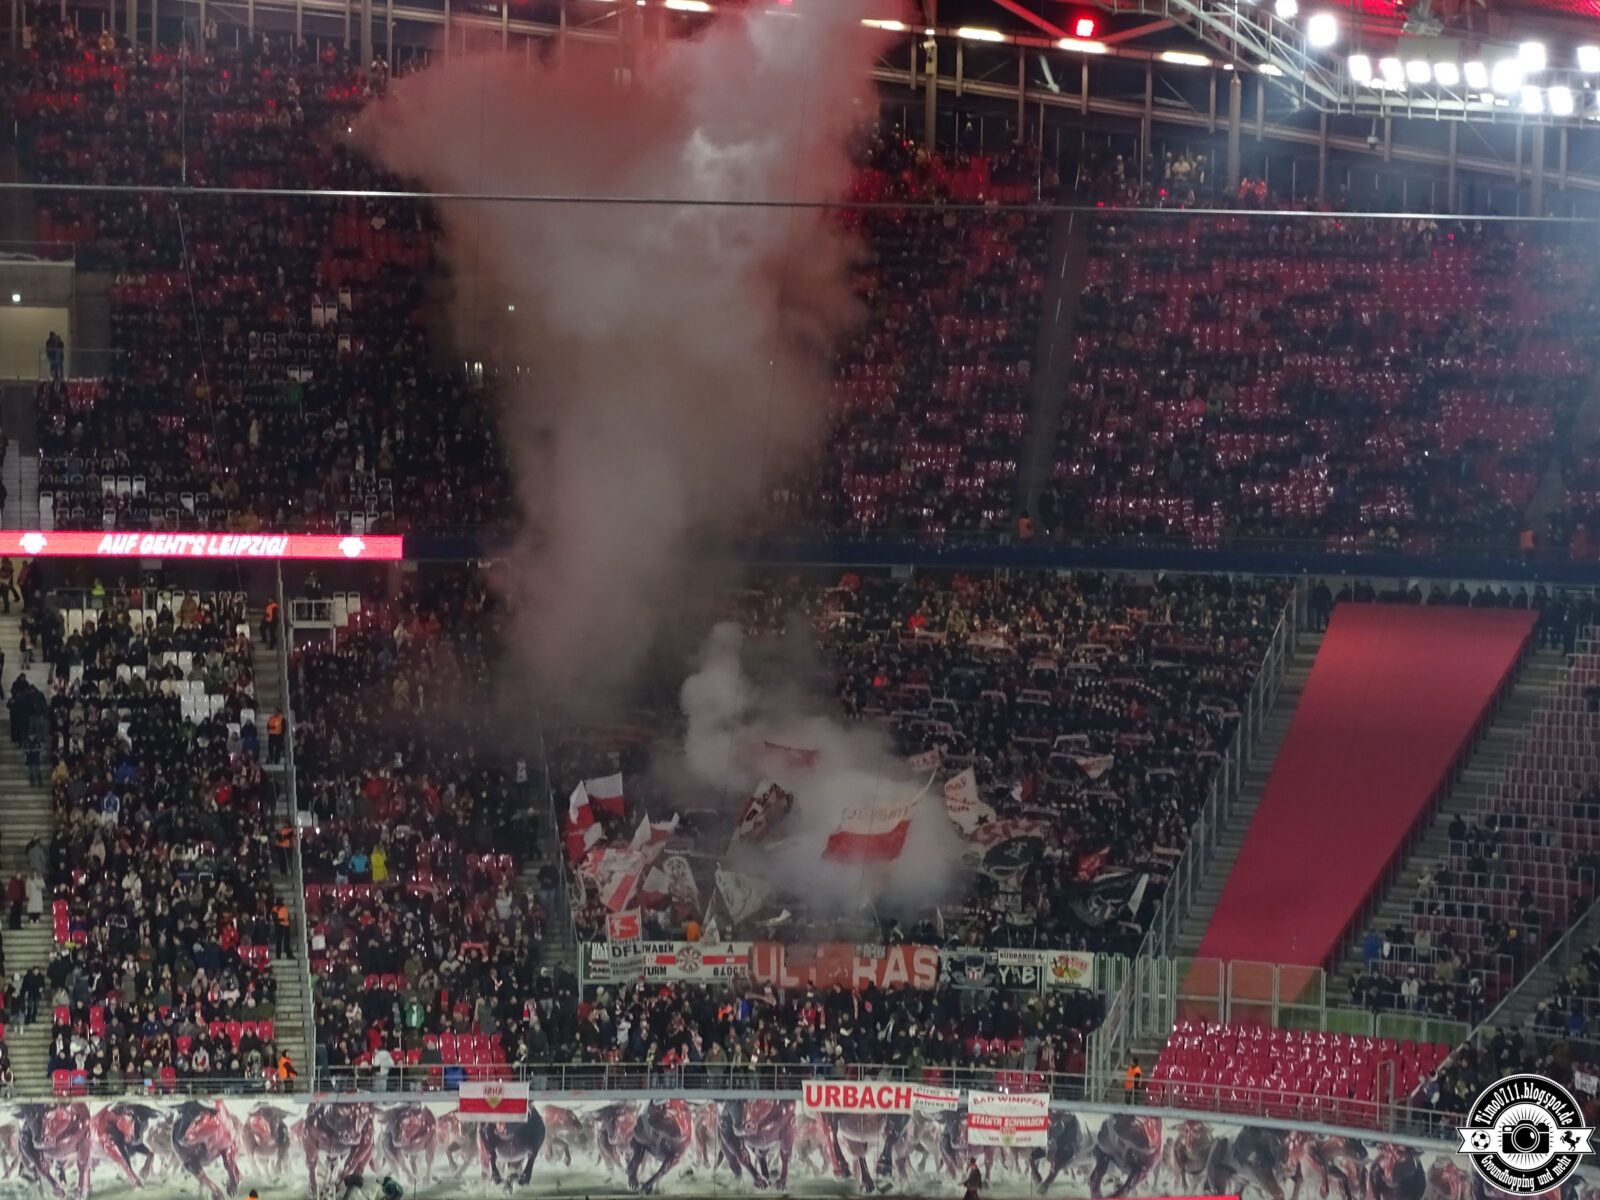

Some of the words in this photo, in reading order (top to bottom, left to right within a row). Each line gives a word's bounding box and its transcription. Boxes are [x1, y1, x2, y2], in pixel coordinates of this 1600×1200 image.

[98, 534, 139, 554] AUF
[139, 534, 207, 556] GEHT'S
[207, 535, 288, 556] LEIPZIG!
[612, 943, 641, 958] DFL
[805, 1084, 913, 1110] URBACH
